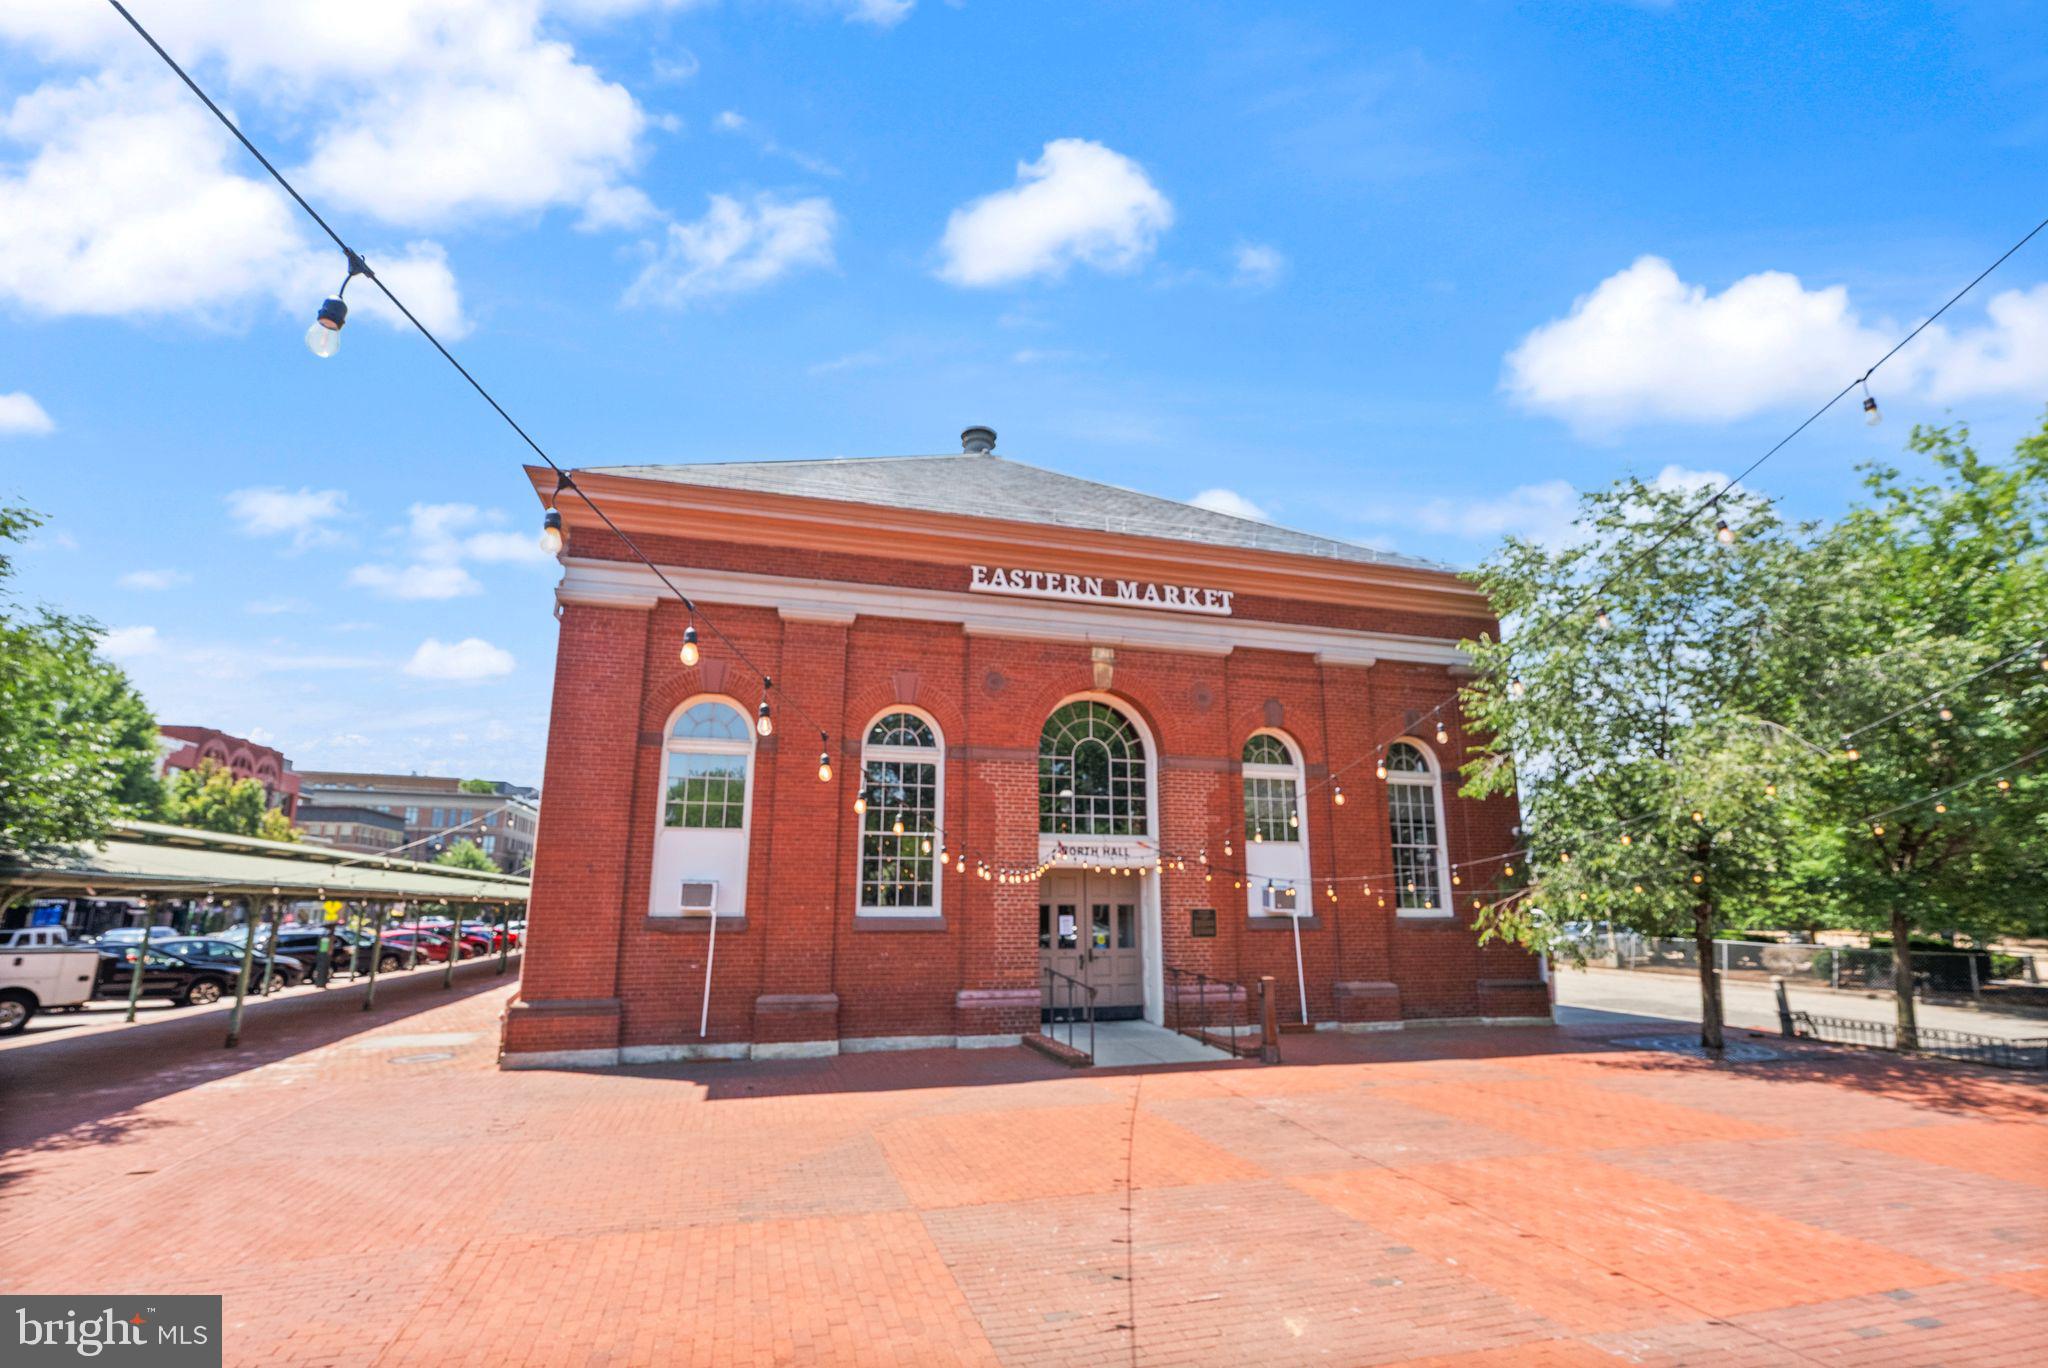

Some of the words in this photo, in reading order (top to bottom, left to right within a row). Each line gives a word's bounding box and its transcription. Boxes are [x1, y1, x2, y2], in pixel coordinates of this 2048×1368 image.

[970, 564, 1104, 596] EASTERN
[1115, 580, 1234, 611] MARKET
[1103, 847, 1129, 857] HALL
